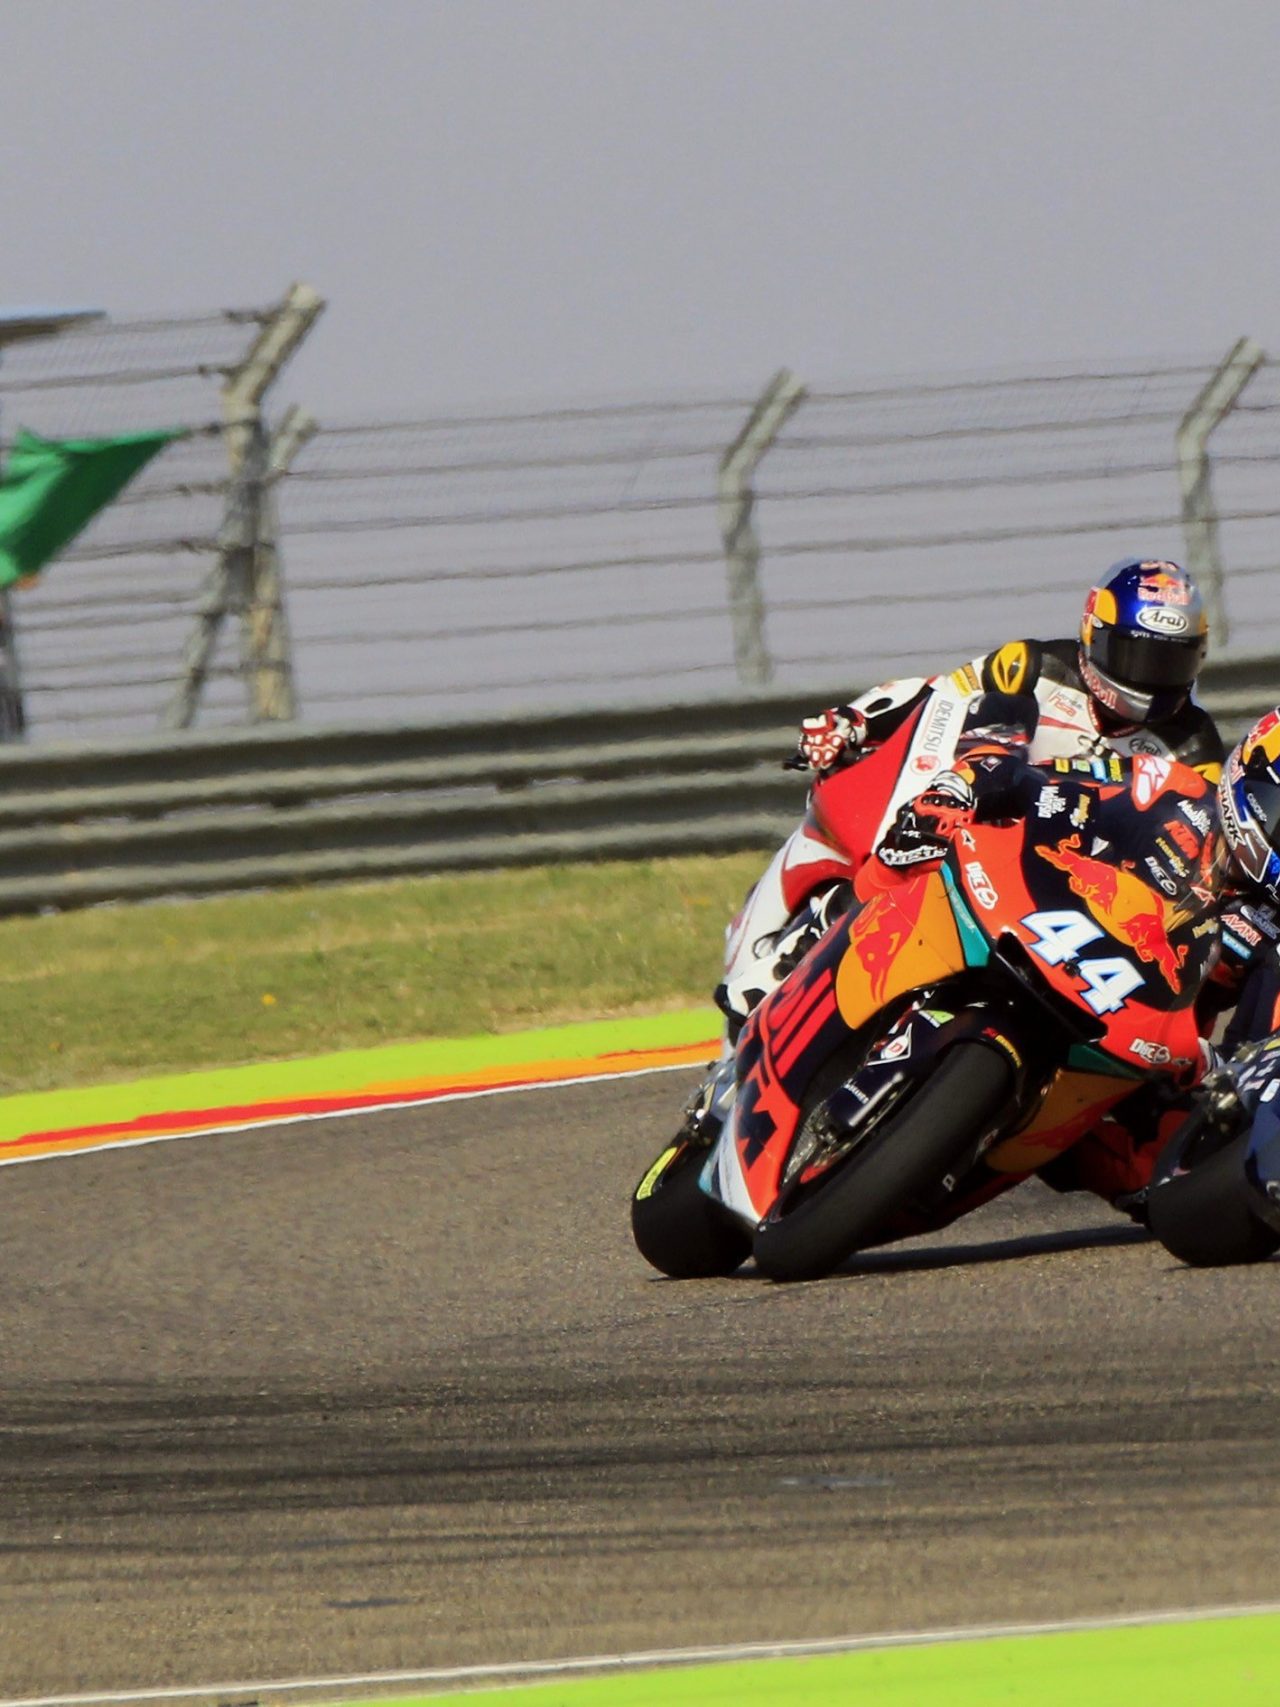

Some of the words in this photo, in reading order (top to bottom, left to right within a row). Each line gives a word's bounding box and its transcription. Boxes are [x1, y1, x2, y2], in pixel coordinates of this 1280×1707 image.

[1149, 610, 1182, 627] Arai
[927, 699, 954, 752] IDEMITSU
[1221, 914, 1262, 946] AVANT
[1020, 910, 1146, 1016] 44
